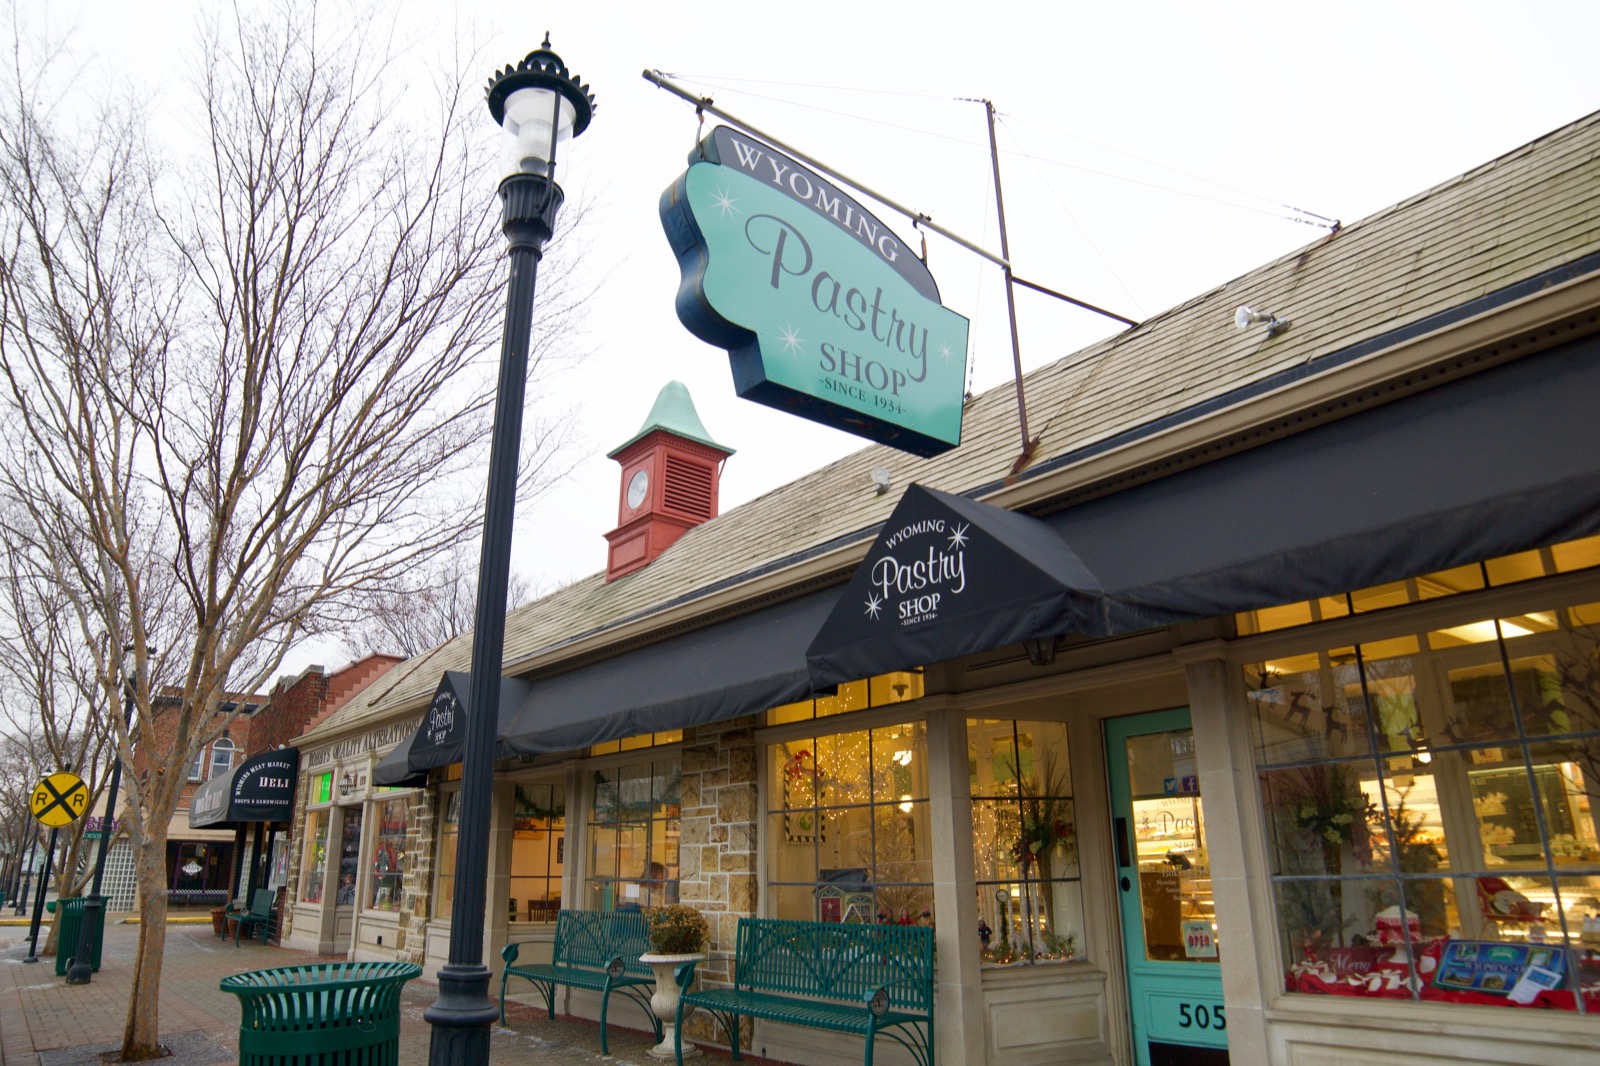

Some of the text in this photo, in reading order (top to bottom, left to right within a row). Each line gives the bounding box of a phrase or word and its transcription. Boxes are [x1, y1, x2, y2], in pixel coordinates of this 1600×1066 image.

[730, 137, 899, 264] WYOMING
[744, 213, 929, 383] Pastry
[819, 342, 906, 398] SHOP
[886, 520, 945, 550] WYOMING
[872, 546, 965, 599] Pastry
[898, 592, 940, 619] SHOP
[430, 705, 454, 732] Pastry
[332, 738, 361, 760] QUALITY
[435, 730, 446, 742] SHOP
[236, 761, 290, 796] WYOMING MEAT MARKET
[259, 777, 289, 788] DELI
[36, 792, 84, 807] R R
[1178, 1003, 1227, 1031] 505
